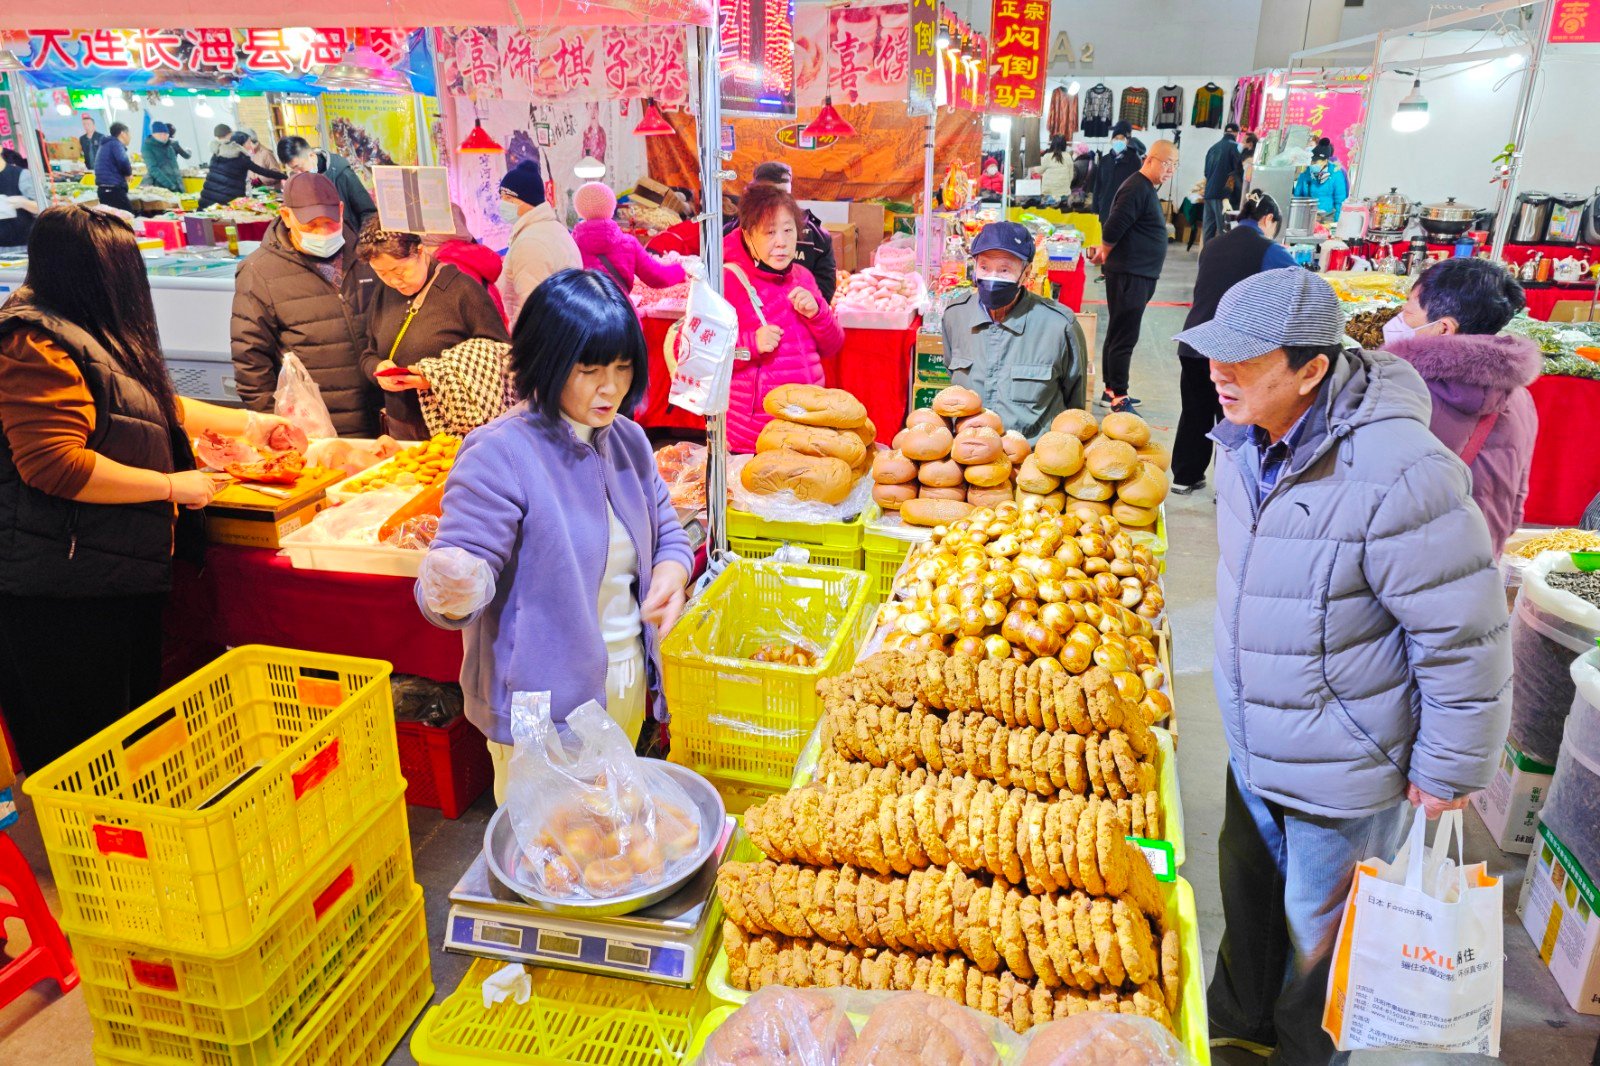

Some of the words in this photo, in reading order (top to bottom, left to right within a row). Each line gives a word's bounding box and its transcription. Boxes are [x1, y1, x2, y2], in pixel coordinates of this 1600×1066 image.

[997, 1, 1045, 21] 正宗
[914, 0, 936, 98] 倒驴
[993, 23, 1040, 109] 闷倒驴
[1401, 943, 1456, 971] LIXIL
